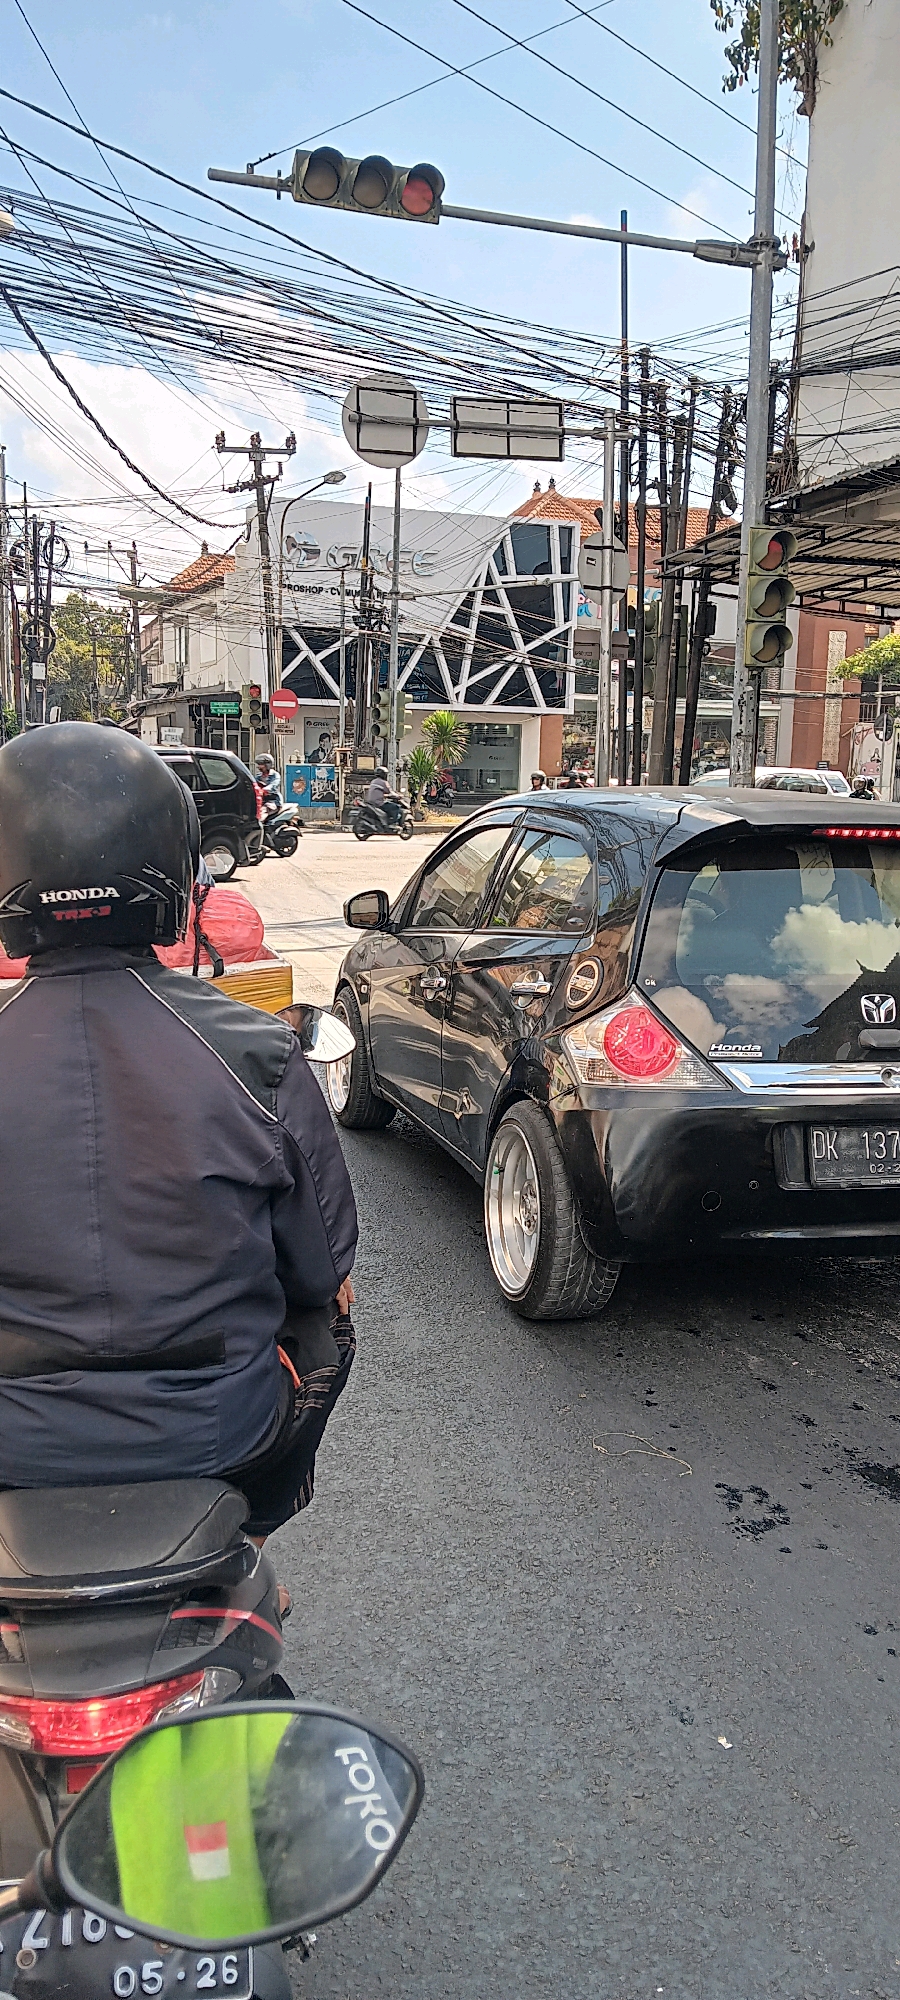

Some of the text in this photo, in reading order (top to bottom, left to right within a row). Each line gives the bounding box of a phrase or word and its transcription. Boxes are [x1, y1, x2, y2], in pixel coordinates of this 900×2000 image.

[282, 583, 323, 595] PROSHOP
[39, 887, 120, 904] HONDA
[813, 1130, 900, 1160] DK 137
[334, 1746, 397, 1868] FOKO
